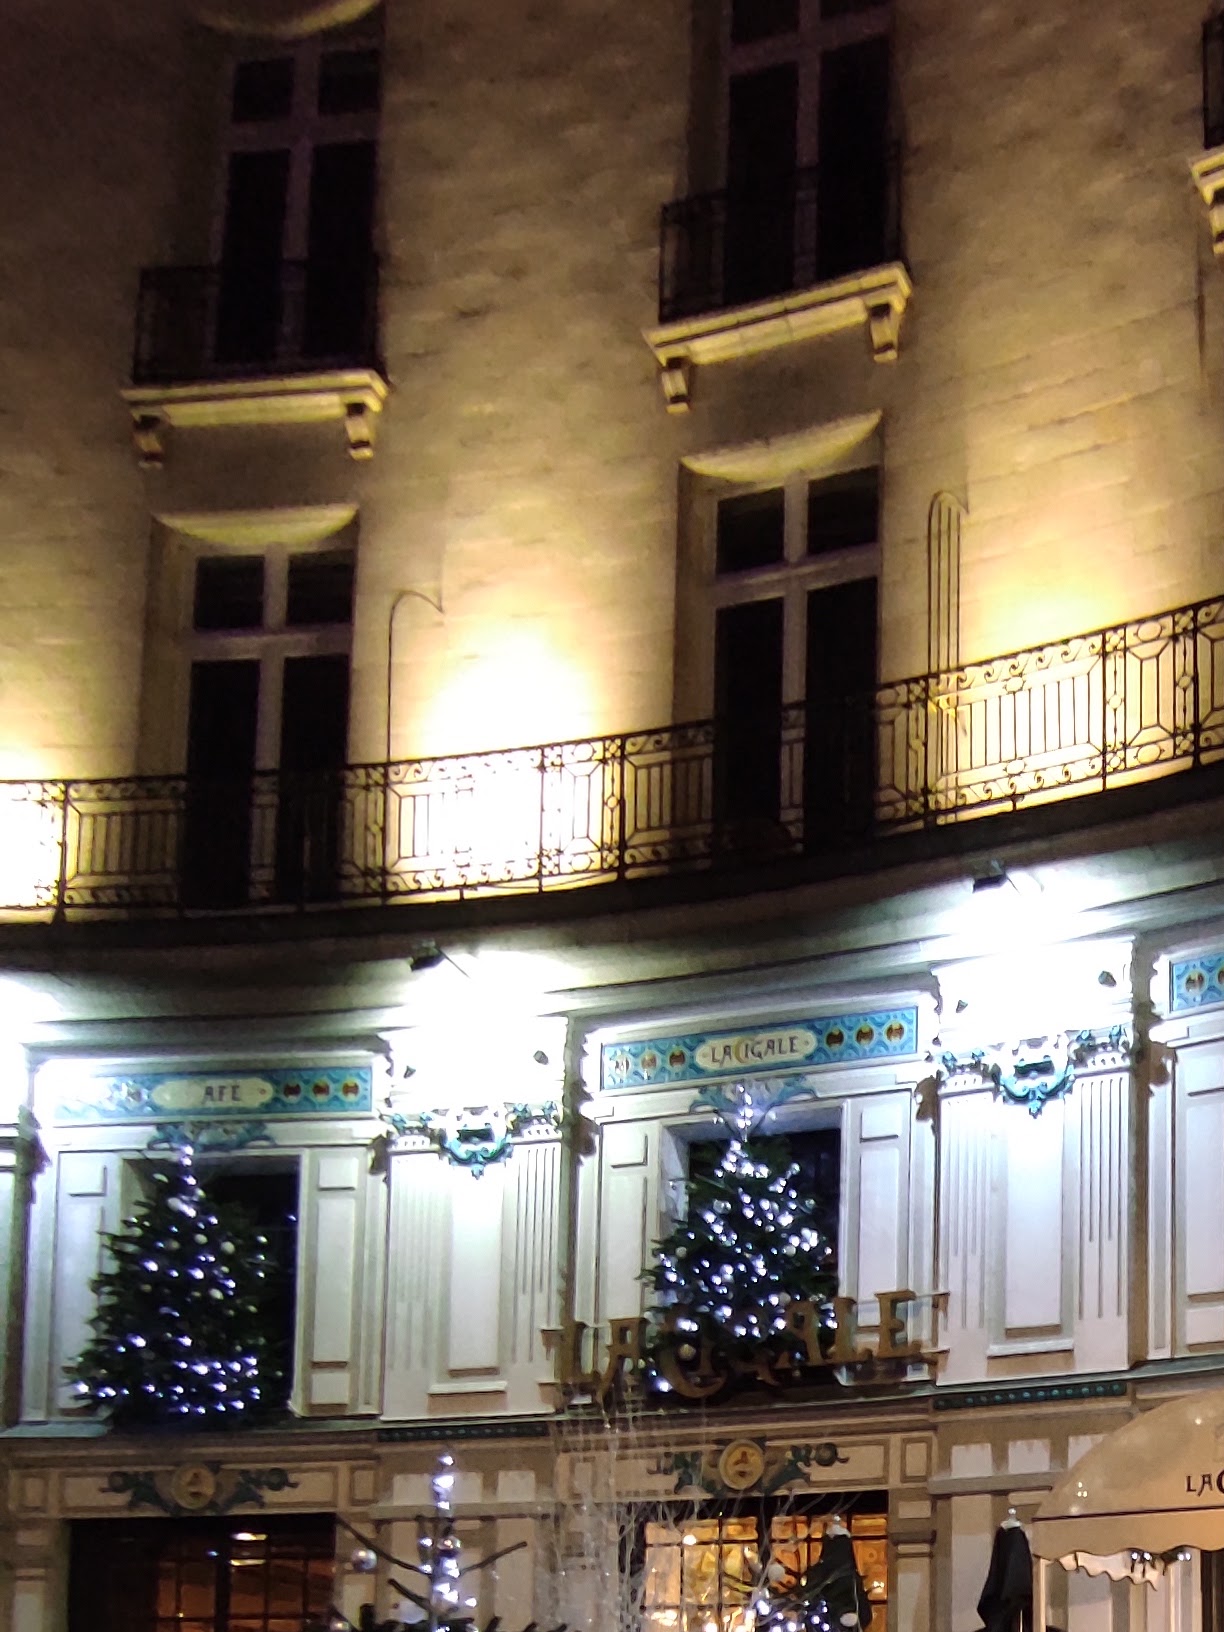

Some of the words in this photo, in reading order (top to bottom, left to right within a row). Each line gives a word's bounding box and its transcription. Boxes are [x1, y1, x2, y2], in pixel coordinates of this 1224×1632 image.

[711, 1045, 732, 1068] LA
[733, 1035, 799, 1064] CIGALE
[558, 1318, 648, 1402] LA
[1186, 1473, 1213, 1498] LA
